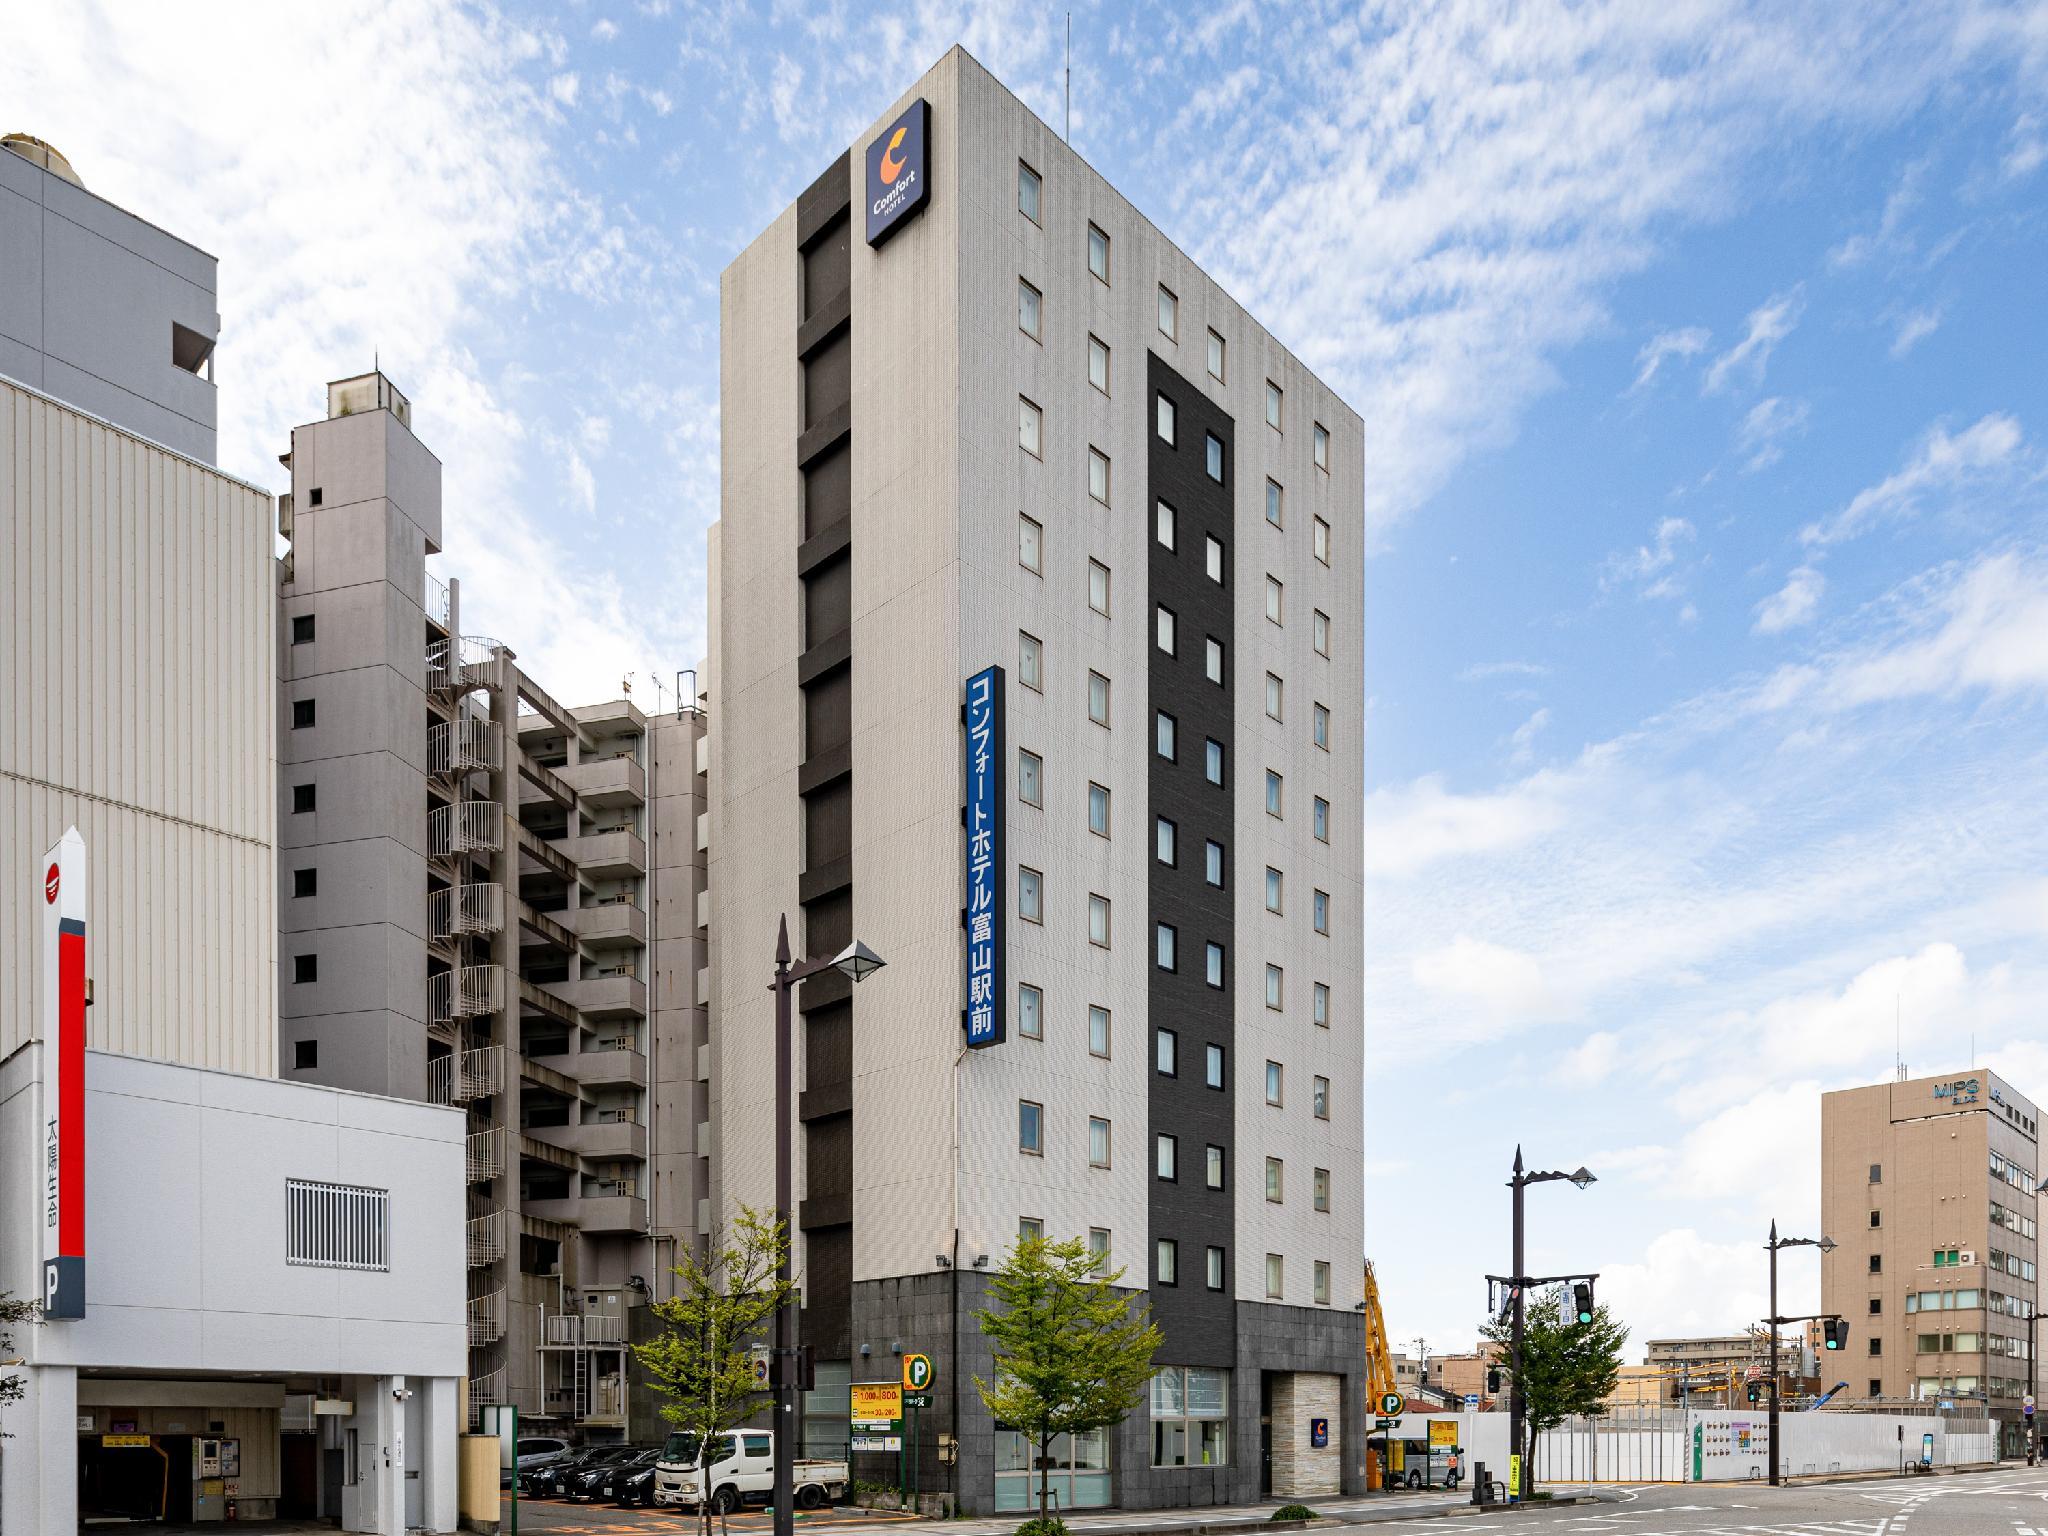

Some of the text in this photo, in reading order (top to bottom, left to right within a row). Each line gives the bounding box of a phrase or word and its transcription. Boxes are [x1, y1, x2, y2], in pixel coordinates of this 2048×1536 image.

[873, 169, 916, 215] Comfort
[884, 194, 906, 217] HOTEL
[971, 676, 993, 1037] コンフォートホテル富山駅前
[1934, 1079, 1979, 1099] MIPS
[47, 1114, 58, 1228] 太陽生命
[46, 1264, 59, 1310] P
[914, 1361, 926, 1384] P
[1386, 1396, 1398, 1412] P
